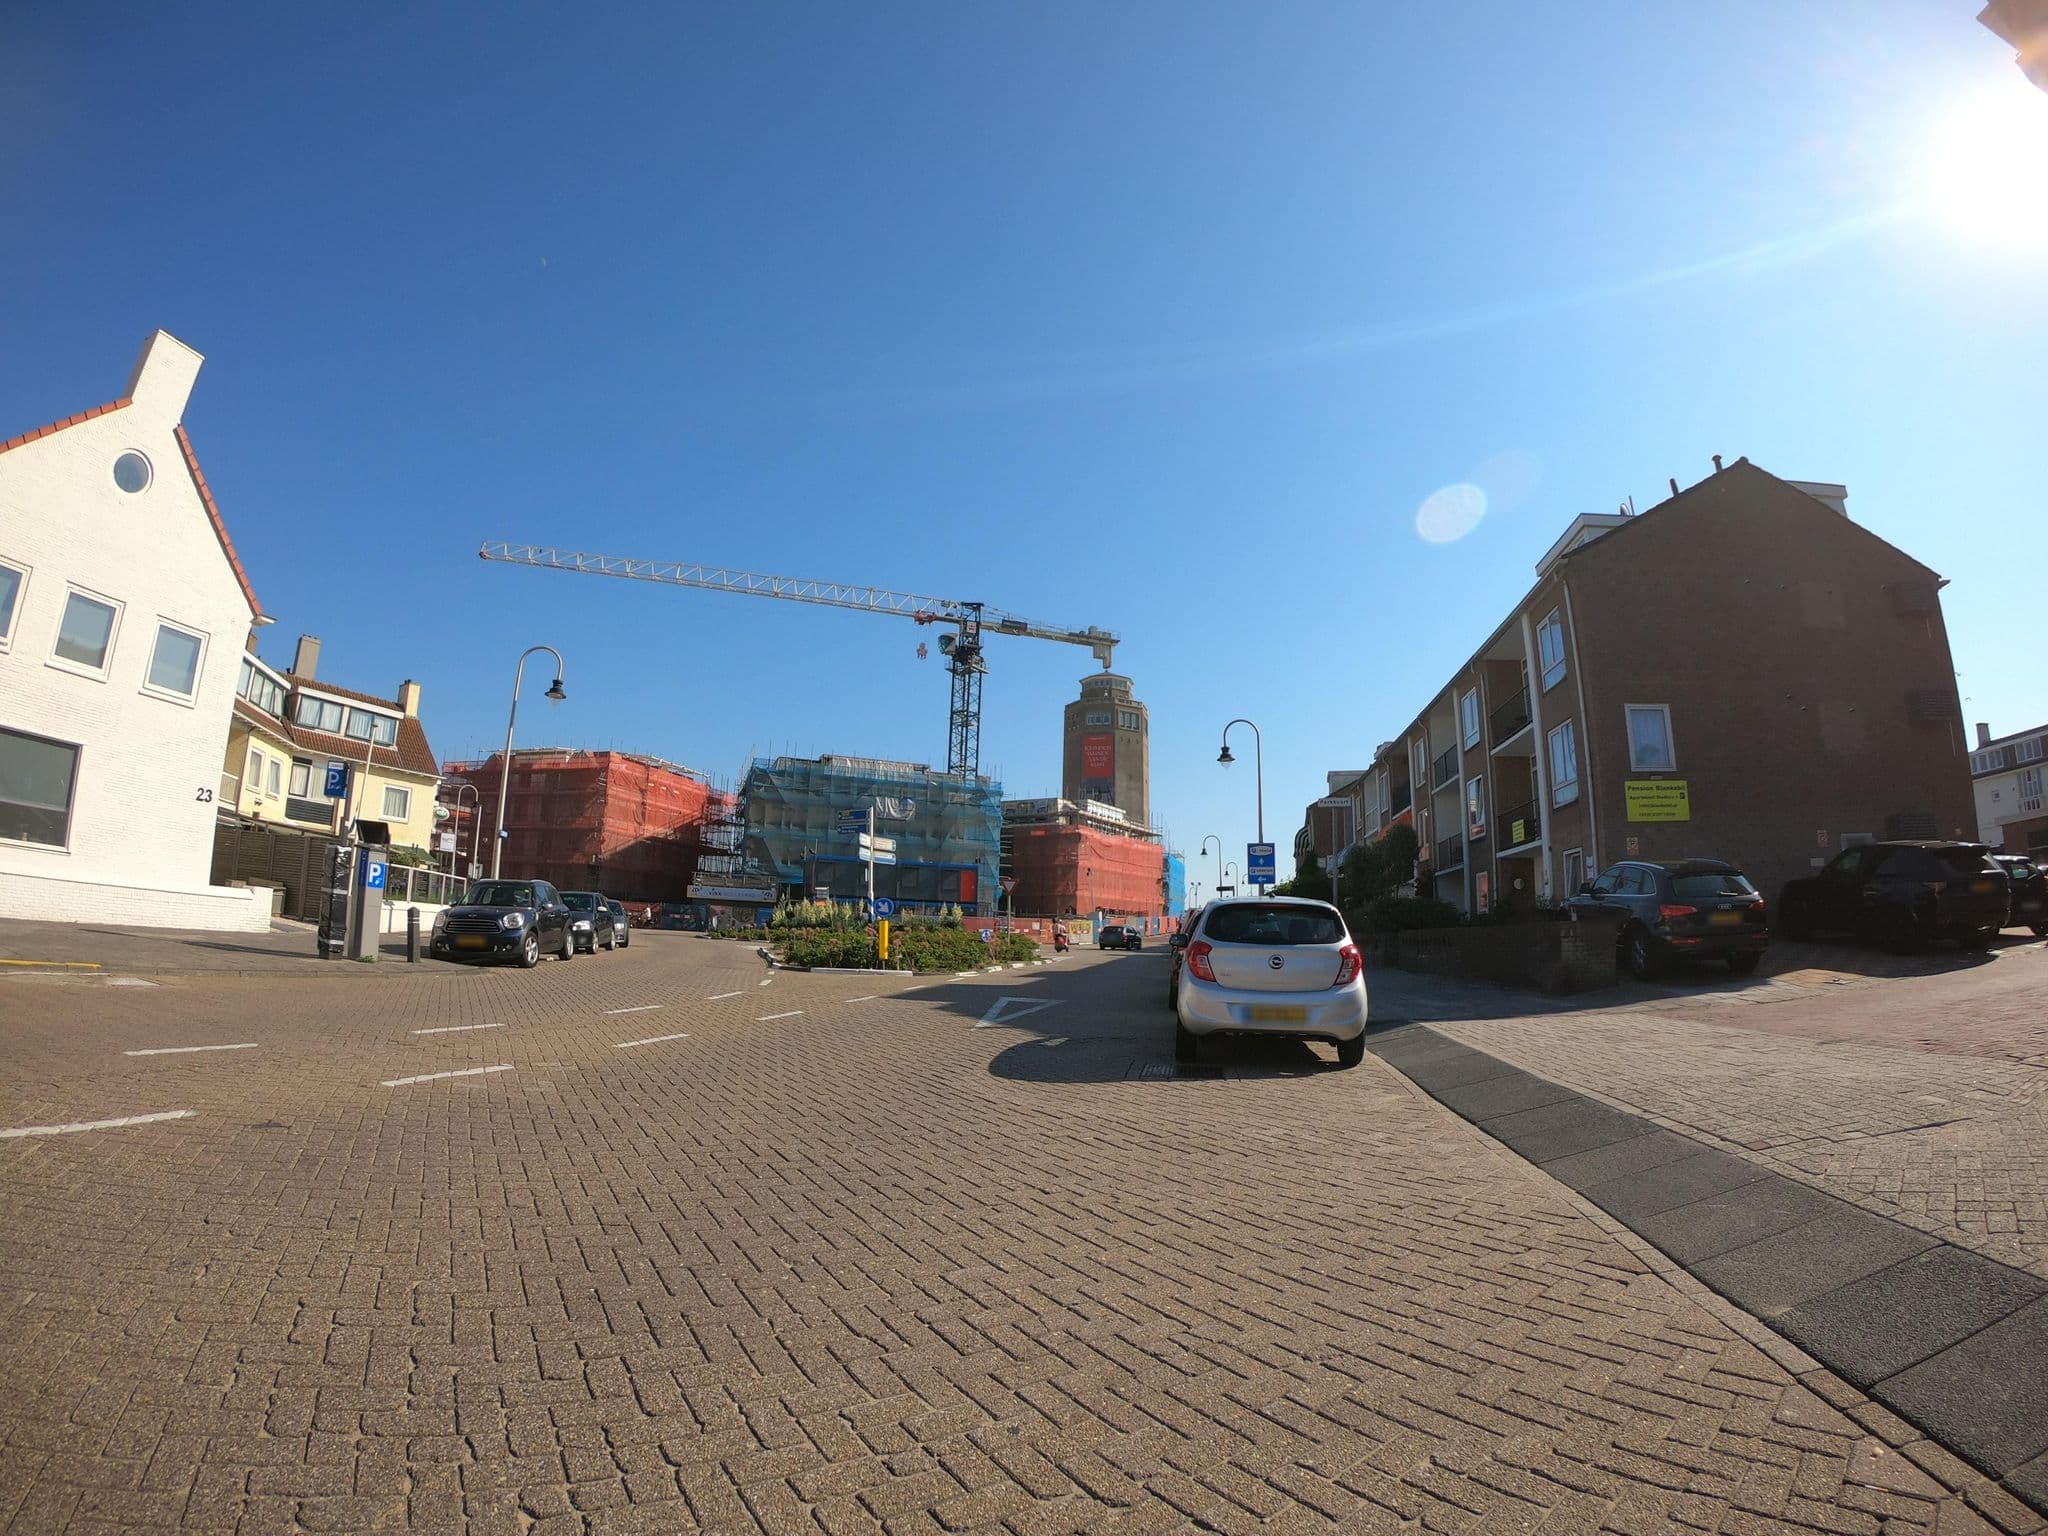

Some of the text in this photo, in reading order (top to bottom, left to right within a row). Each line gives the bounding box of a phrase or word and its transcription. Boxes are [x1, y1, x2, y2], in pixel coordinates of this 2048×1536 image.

[328, 772, 339, 789] P
[195, 787, 213, 803] 23
[369, 864, 382, 883] P
